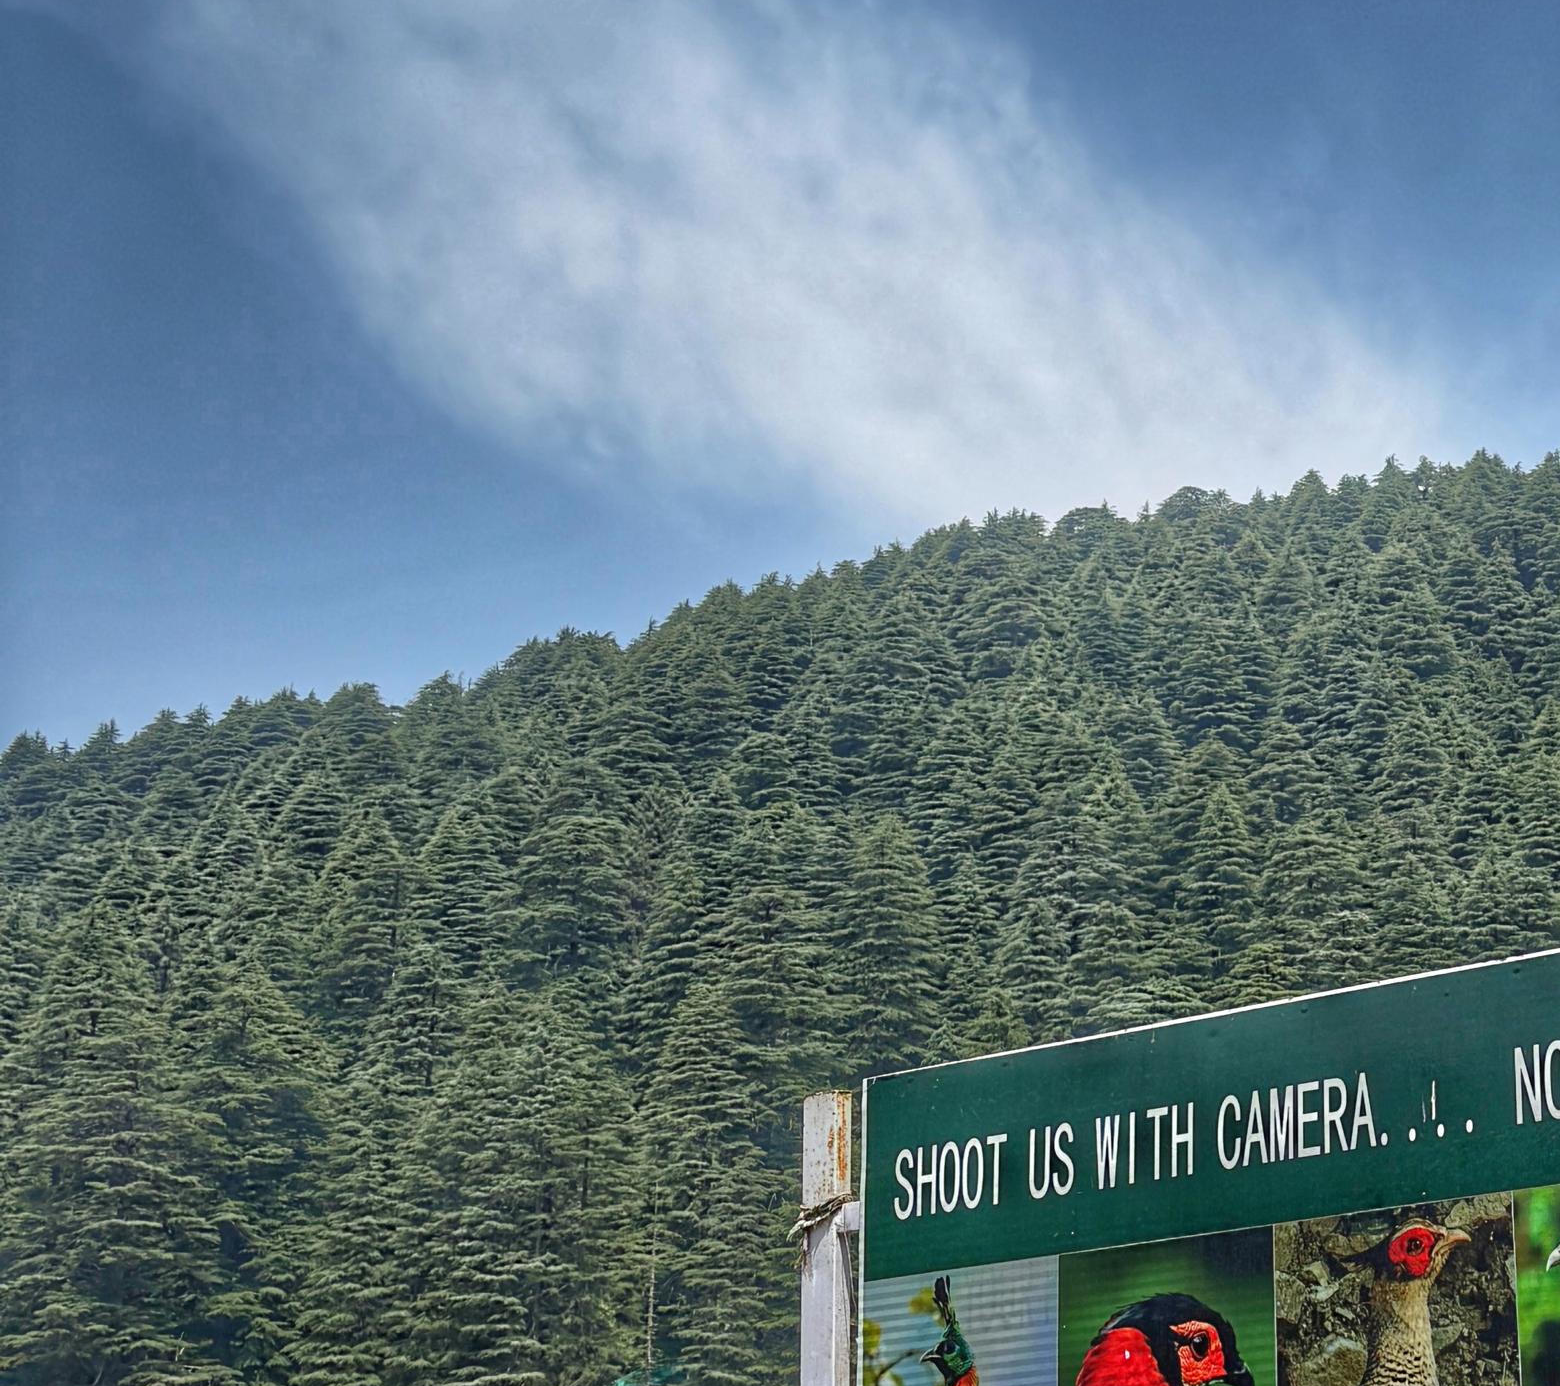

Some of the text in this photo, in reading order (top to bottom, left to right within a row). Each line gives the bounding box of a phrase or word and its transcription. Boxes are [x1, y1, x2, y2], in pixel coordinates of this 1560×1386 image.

[893, 1132, 1009, 1221] SHOOT
[1027, 1121, 1075, 1200] US
[1094, 1100, 1195, 1191] WITH
